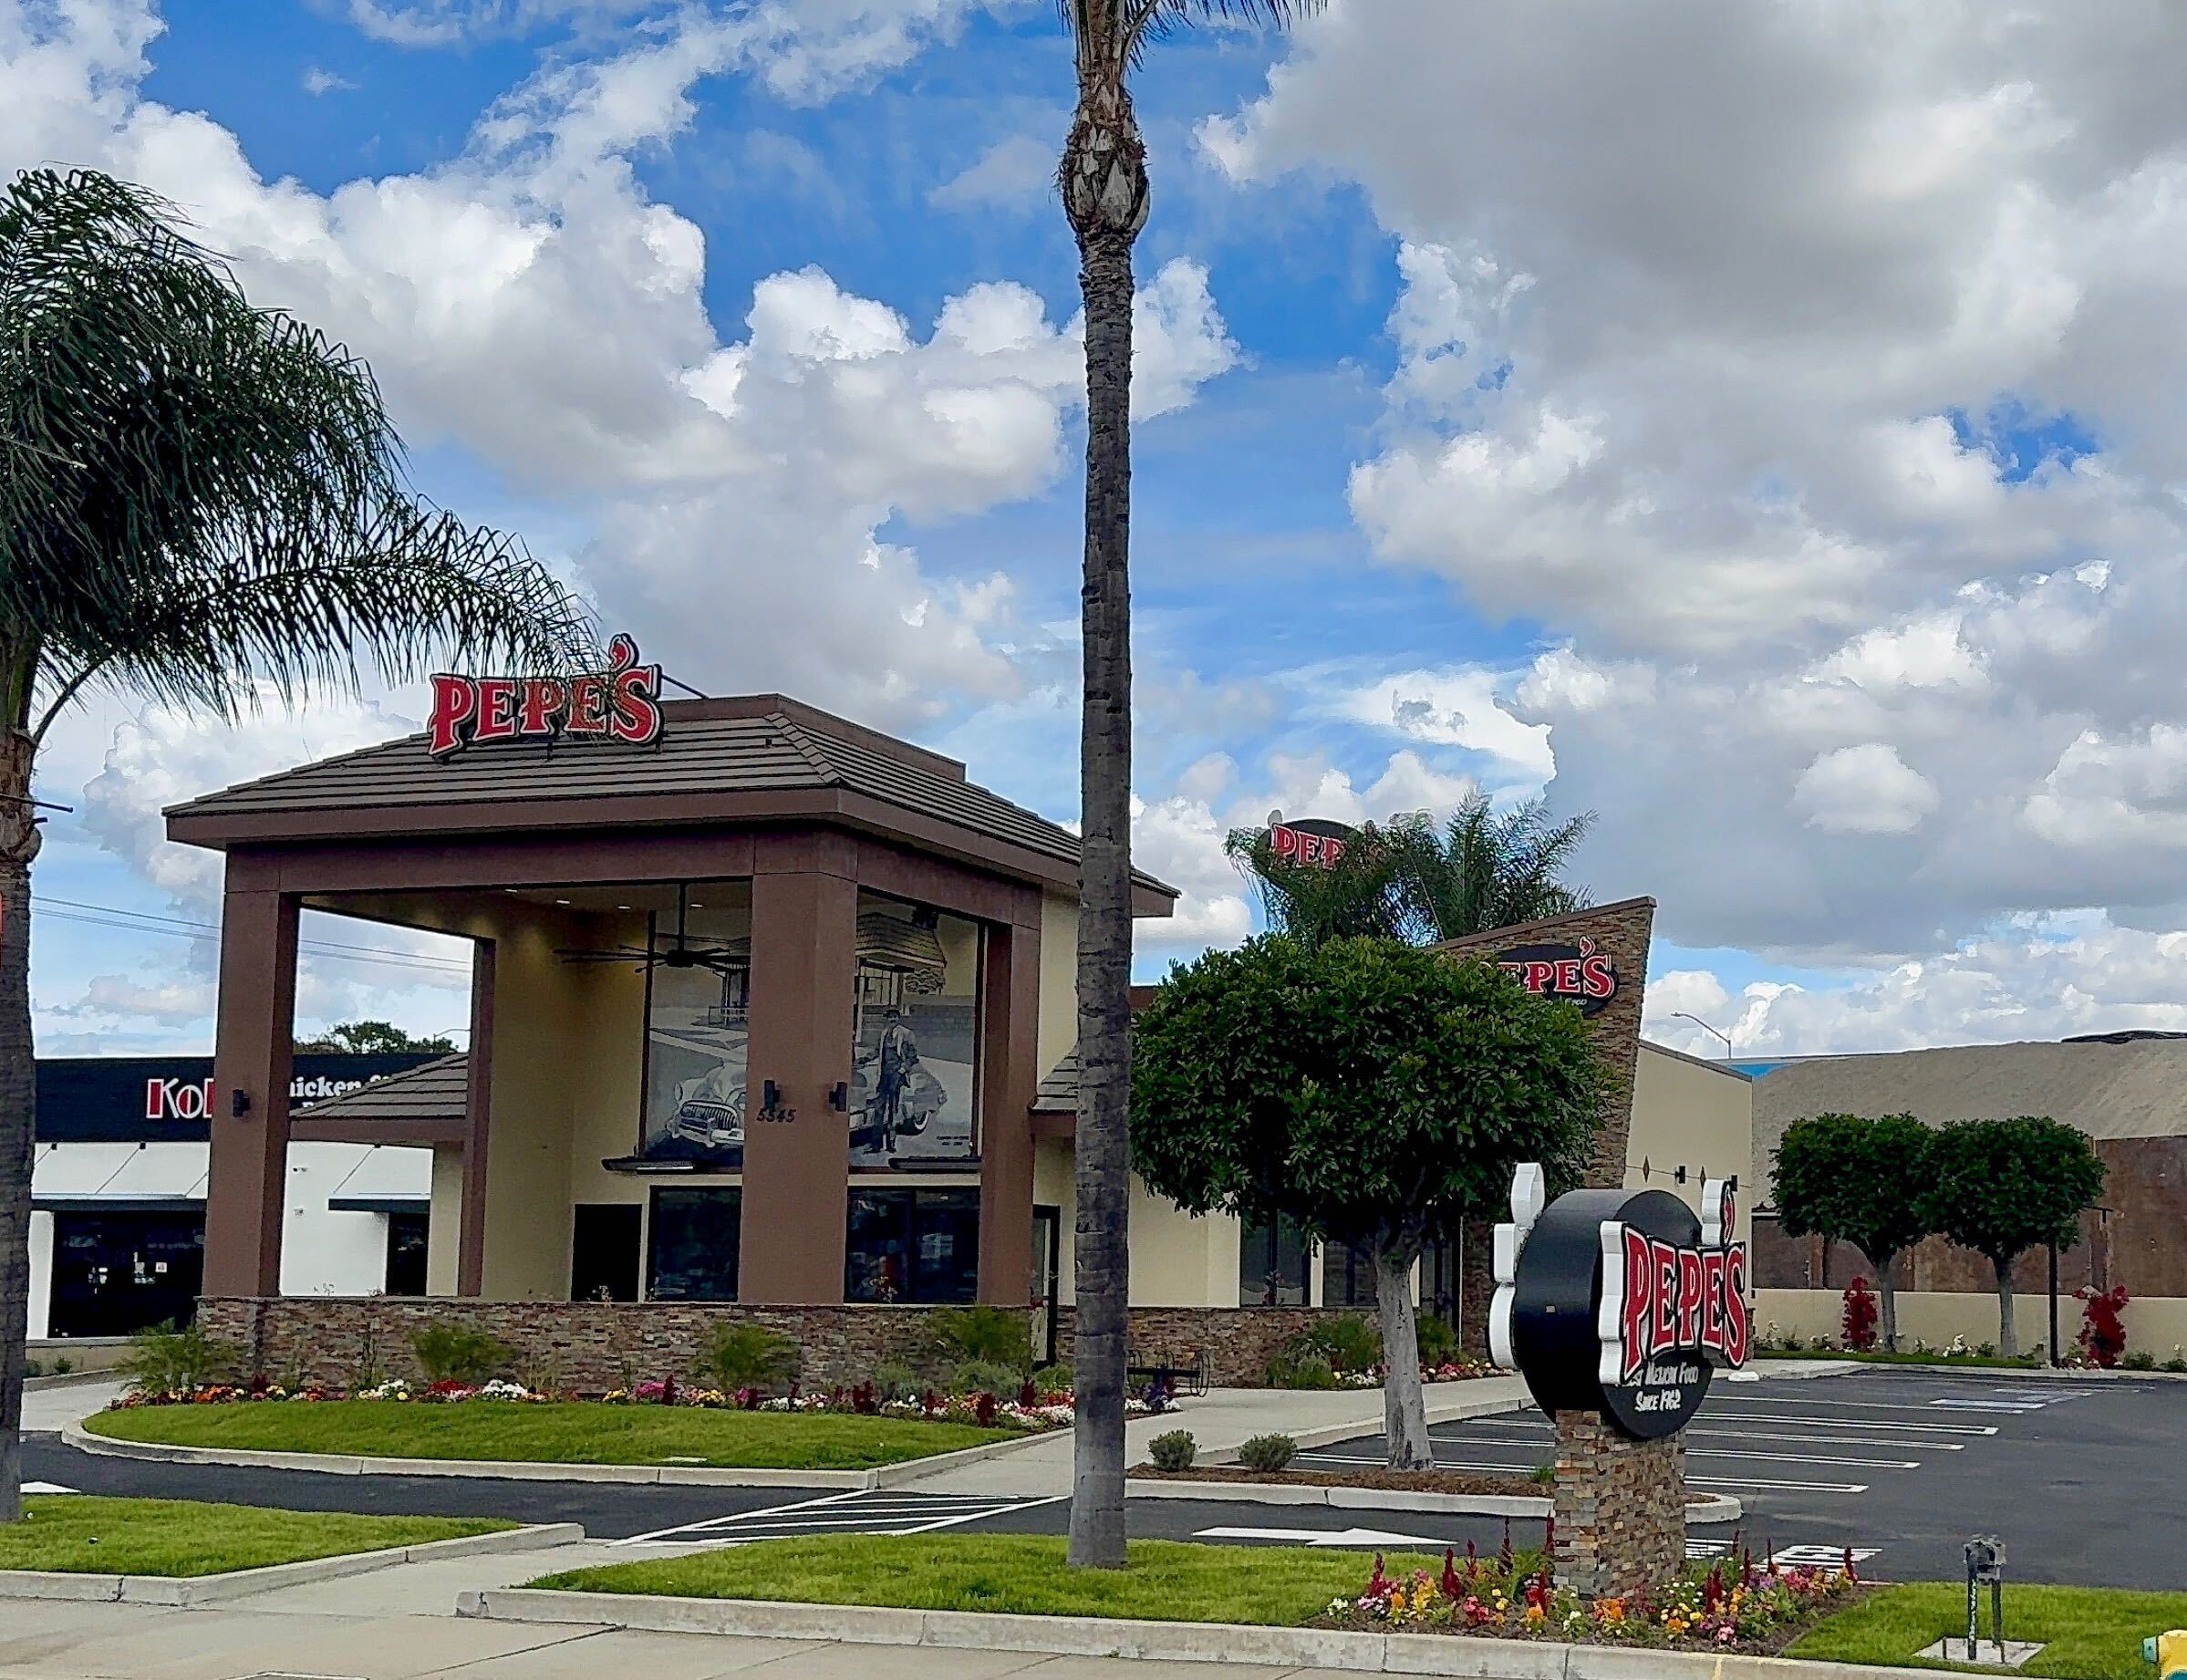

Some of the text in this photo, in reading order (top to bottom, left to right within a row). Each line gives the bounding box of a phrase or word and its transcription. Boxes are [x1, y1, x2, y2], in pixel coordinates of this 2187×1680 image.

[428, 632, 660, 755] PEPE'S
[1270, 823, 1346, 870] PEP
[1479, 936, 1615, 999] PE'S
[1623, 1184, 1746, 1382] PEPE'S
